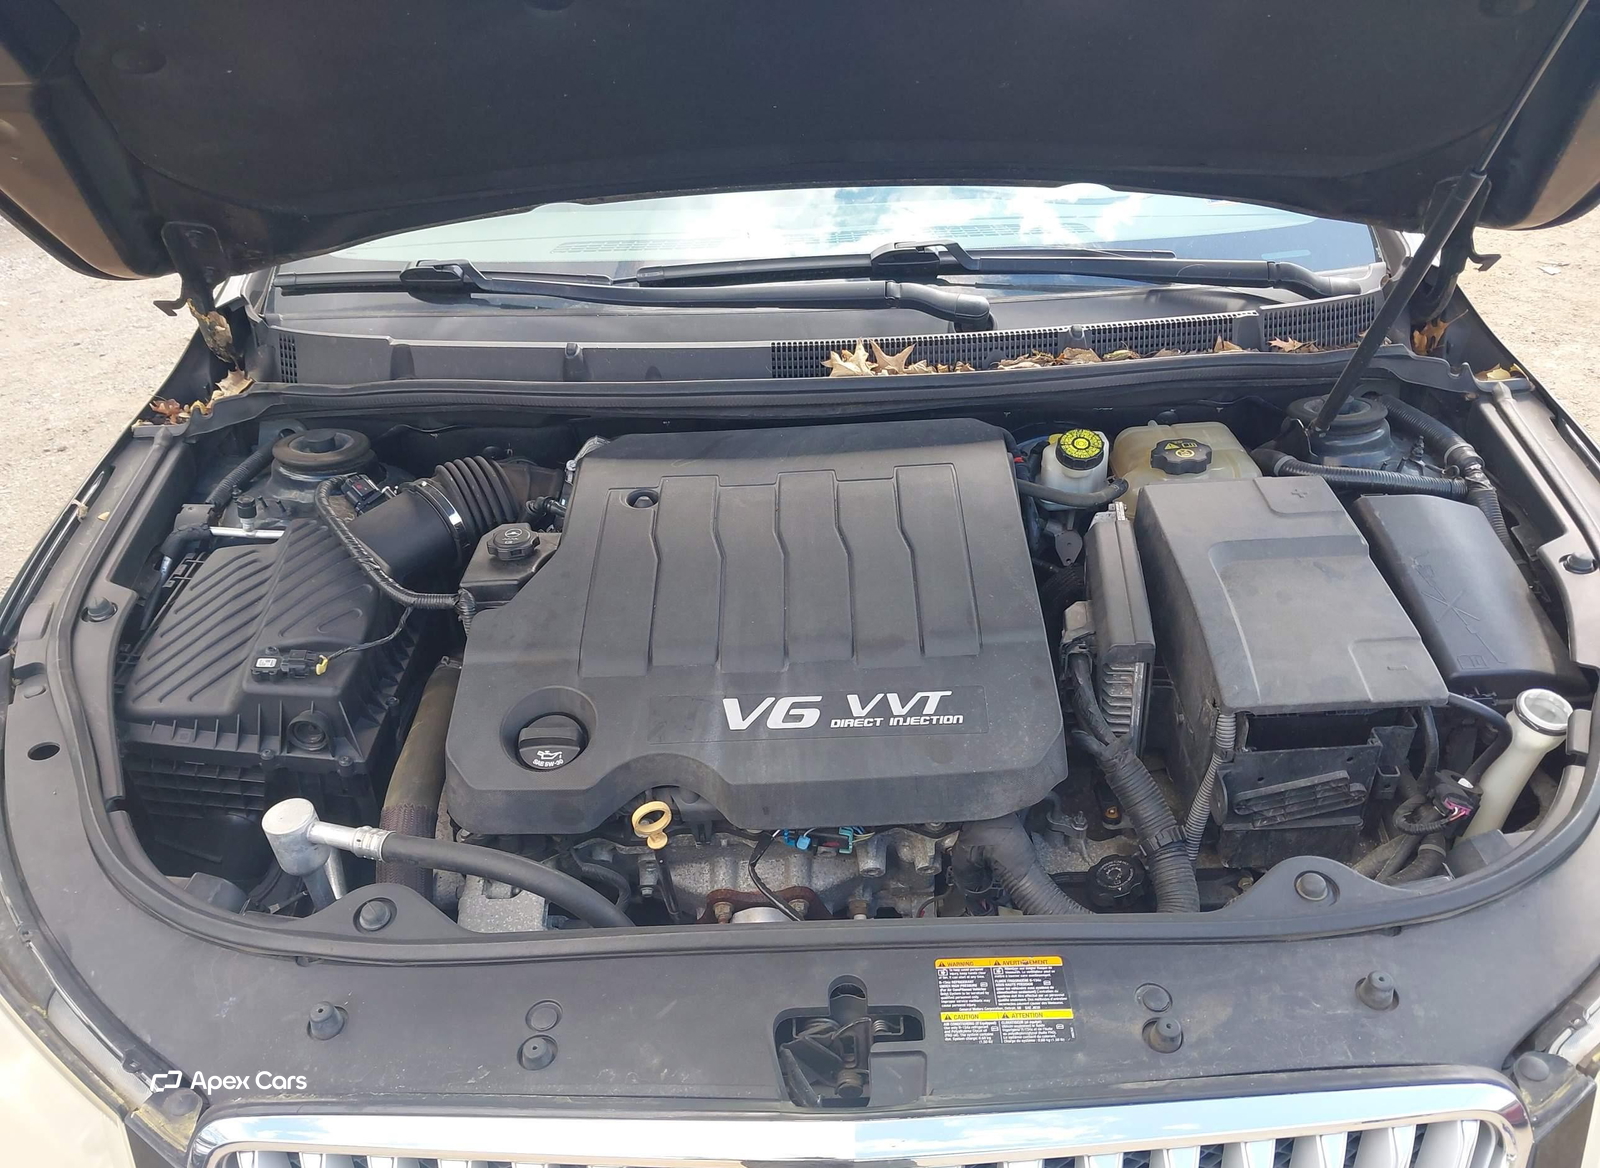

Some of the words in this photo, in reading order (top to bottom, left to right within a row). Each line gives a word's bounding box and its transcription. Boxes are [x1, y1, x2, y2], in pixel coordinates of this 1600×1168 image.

[723, 696, 822, 730] V6
[847, 691, 952, 716] VVT
[830, 717, 883, 728] DIRECT
[889, 715, 963, 726] INJECTION
[533, 759, 545, 767] SAE
